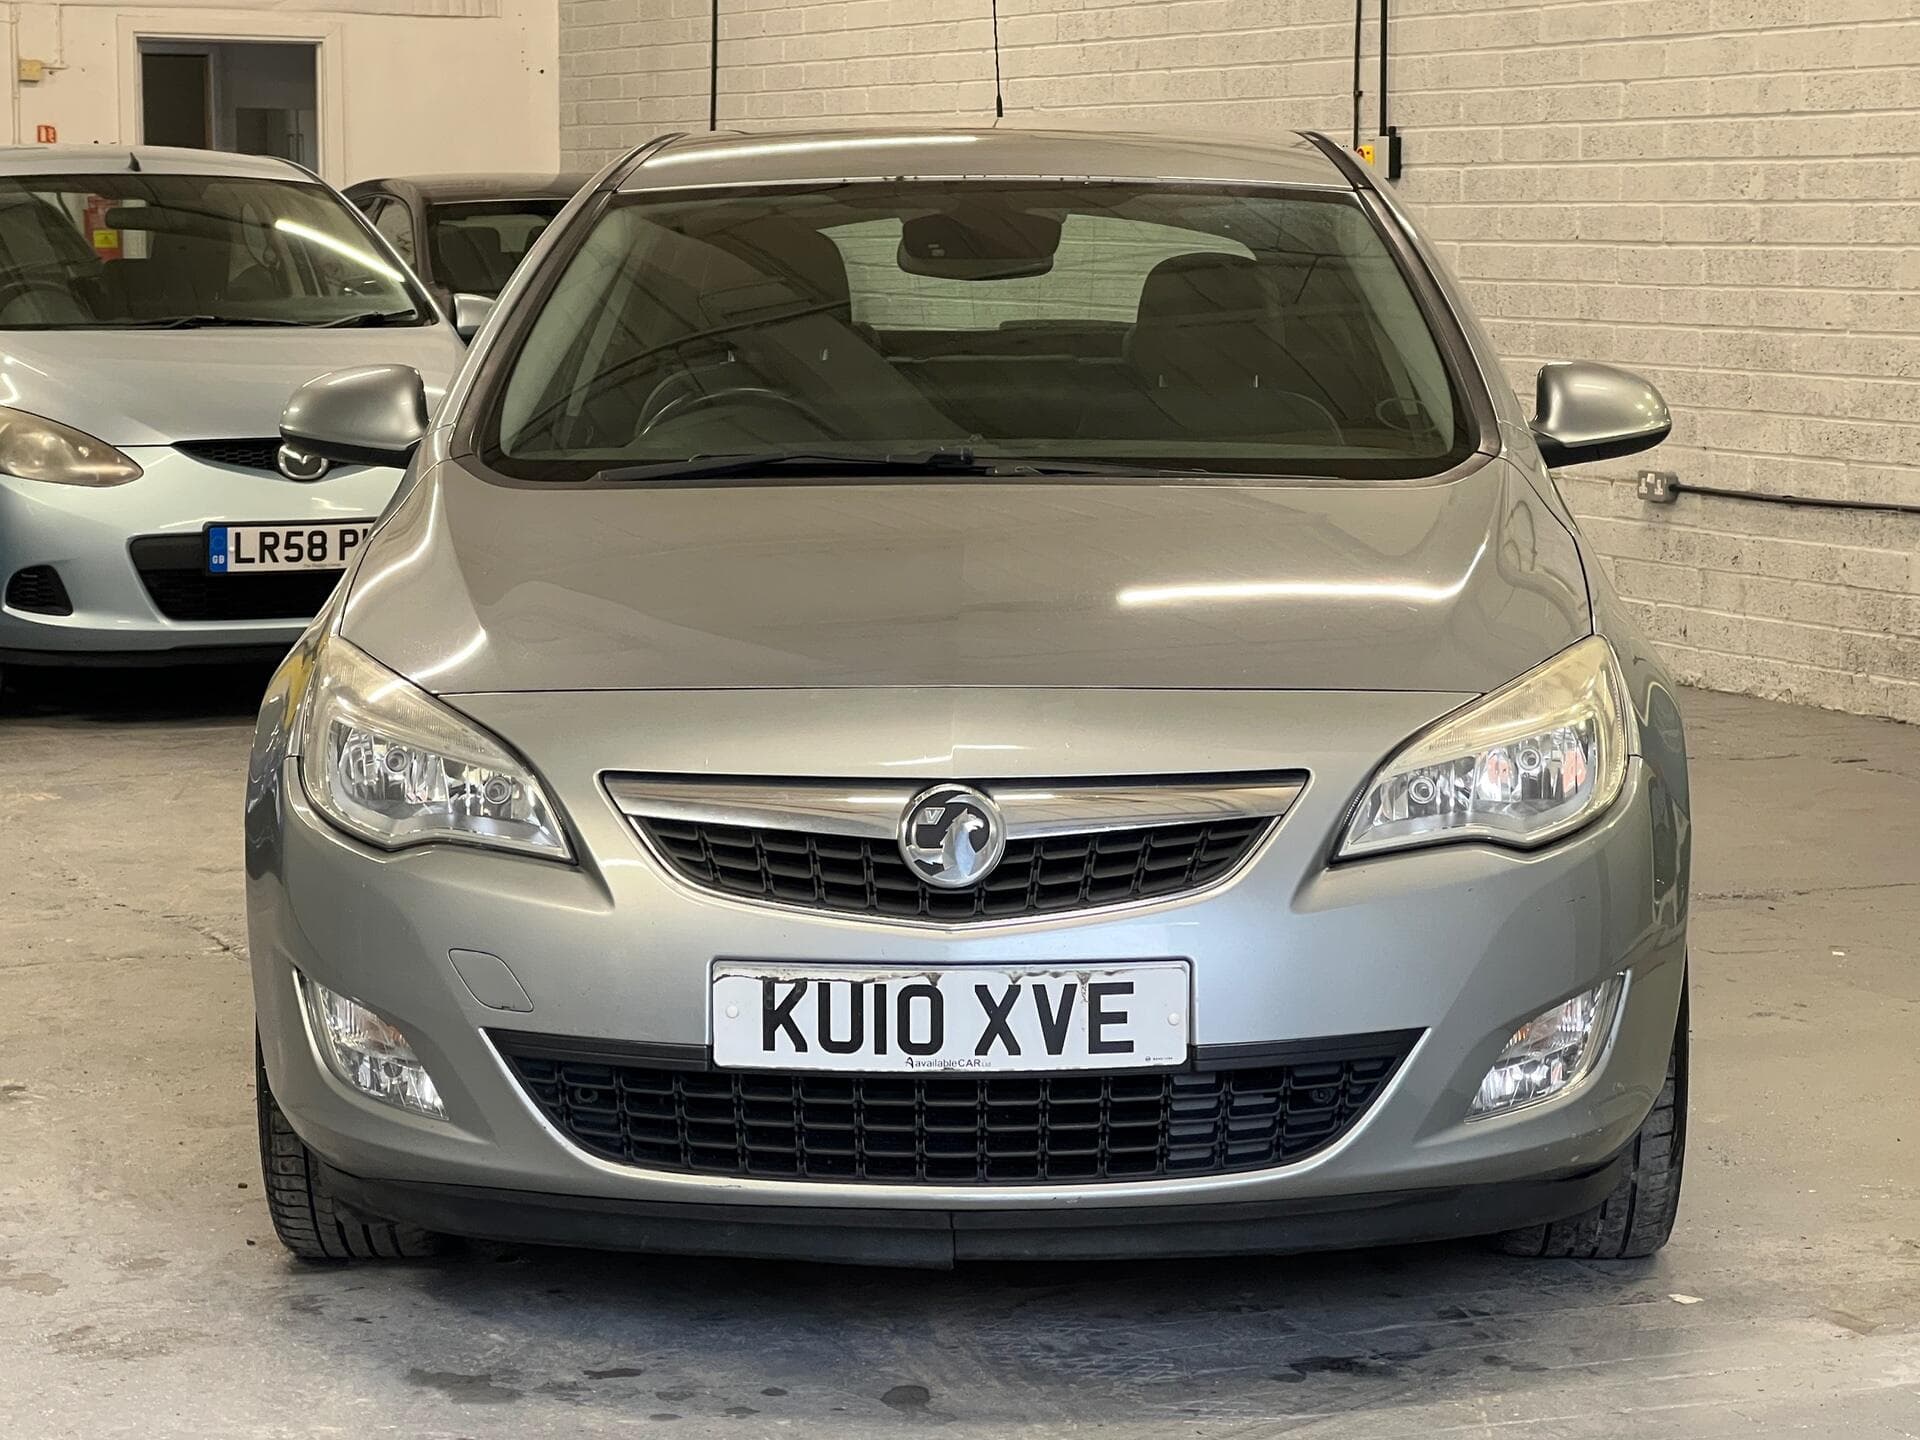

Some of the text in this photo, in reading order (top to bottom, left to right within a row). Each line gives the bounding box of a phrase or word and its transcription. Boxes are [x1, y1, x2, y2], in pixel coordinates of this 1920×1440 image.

[212, 555, 225, 564] GB
[234, 530, 328, 564] LR58
[762, 979, 1135, 1056] KU10 XVE
